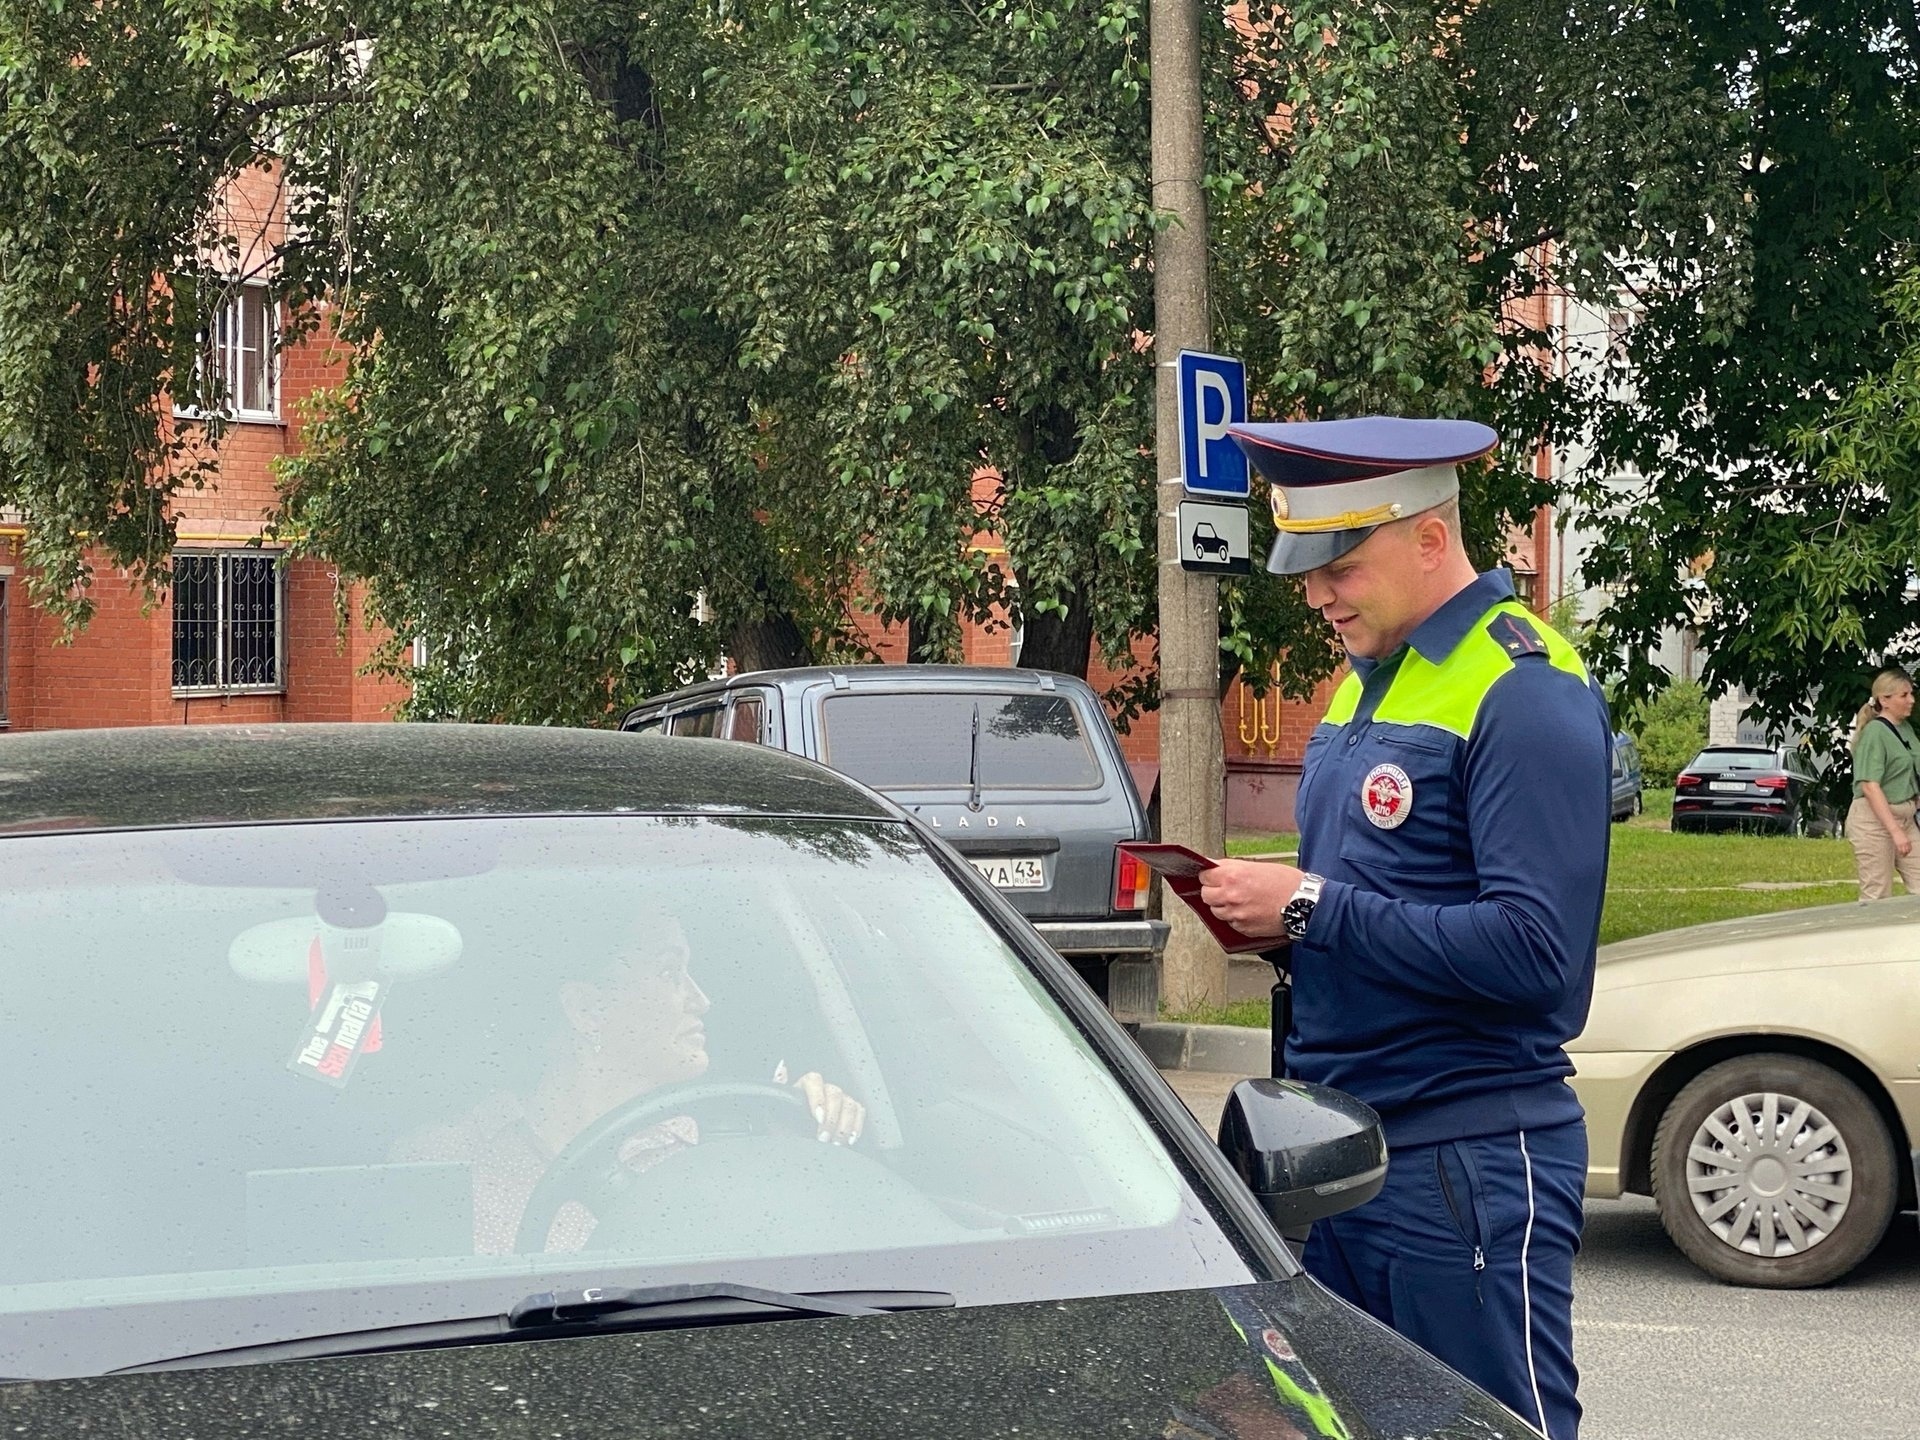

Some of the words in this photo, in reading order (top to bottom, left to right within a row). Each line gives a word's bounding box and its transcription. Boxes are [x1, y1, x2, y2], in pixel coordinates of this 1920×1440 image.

[1195, 369, 1232, 477] P
[1370, 766, 1408, 790] ПОЛИЦИЯ
[932, 816, 1026, 827] LADA
[1015, 861, 1035, 877] 43
[297, 1035, 329, 1068] The
